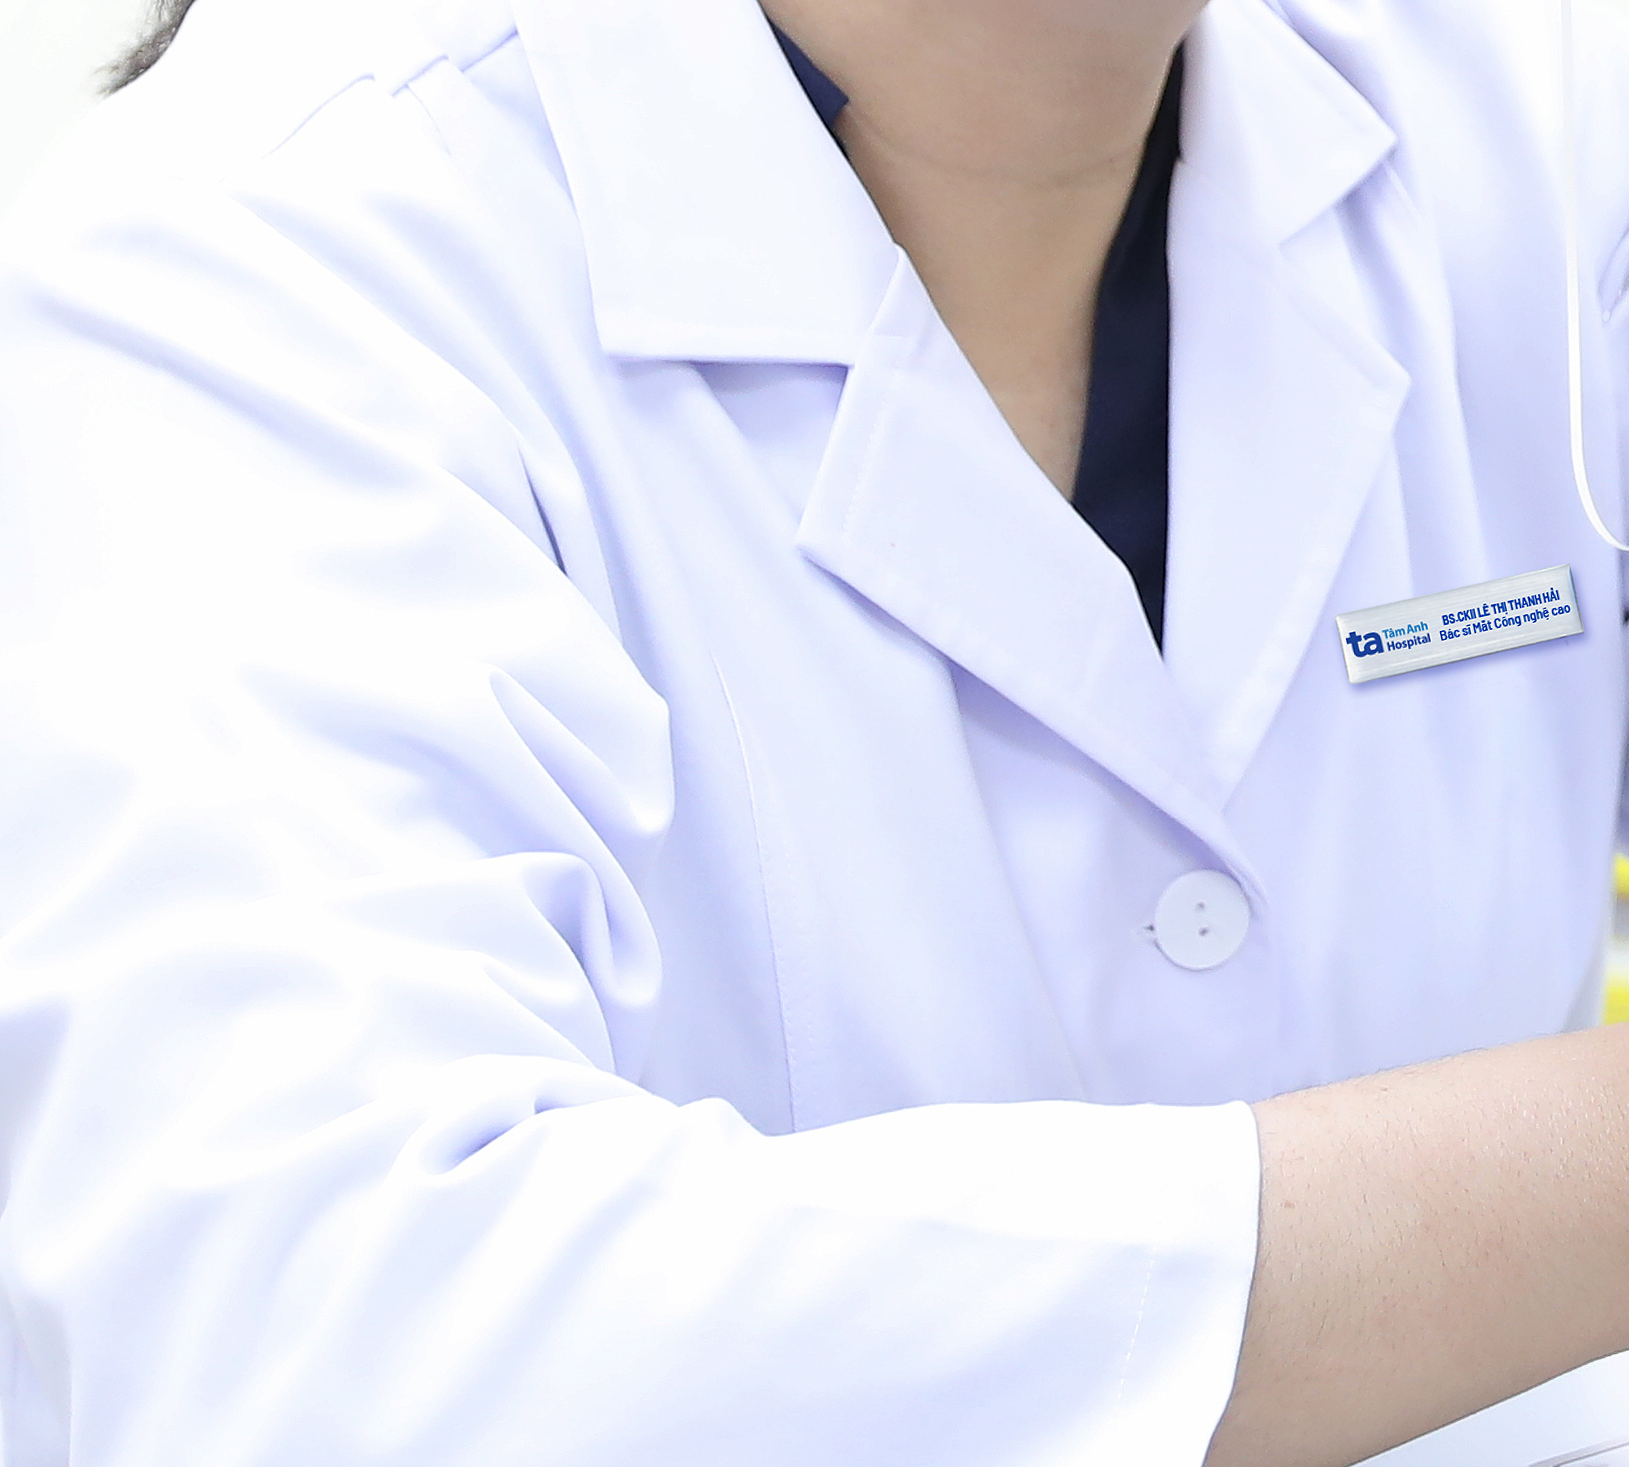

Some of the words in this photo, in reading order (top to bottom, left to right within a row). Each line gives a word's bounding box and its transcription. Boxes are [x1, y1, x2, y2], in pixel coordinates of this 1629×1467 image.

[1477, 603, 1491, 618] LÊ
[1491, 601, 1508, 615] THỊ
[1508, 593, 1542, 611] THANH
[1542, 587, 1560, 603] HẢI
[1382, 627, 1406, 639] Tâm
[1406, 621, 1429, 634] Anh
[1439, 628, 1461, 641] Bác
[1462, 624, 1472, 636] sĩ
[1493, 615, 1522, 629] Công
[1523, 607, 1549, 624] nghệ
[1551, 604, 1571, 616] cao
[1345, 631, 1385, 658] ta
[1386, 632, 1432, 652] Hospital
